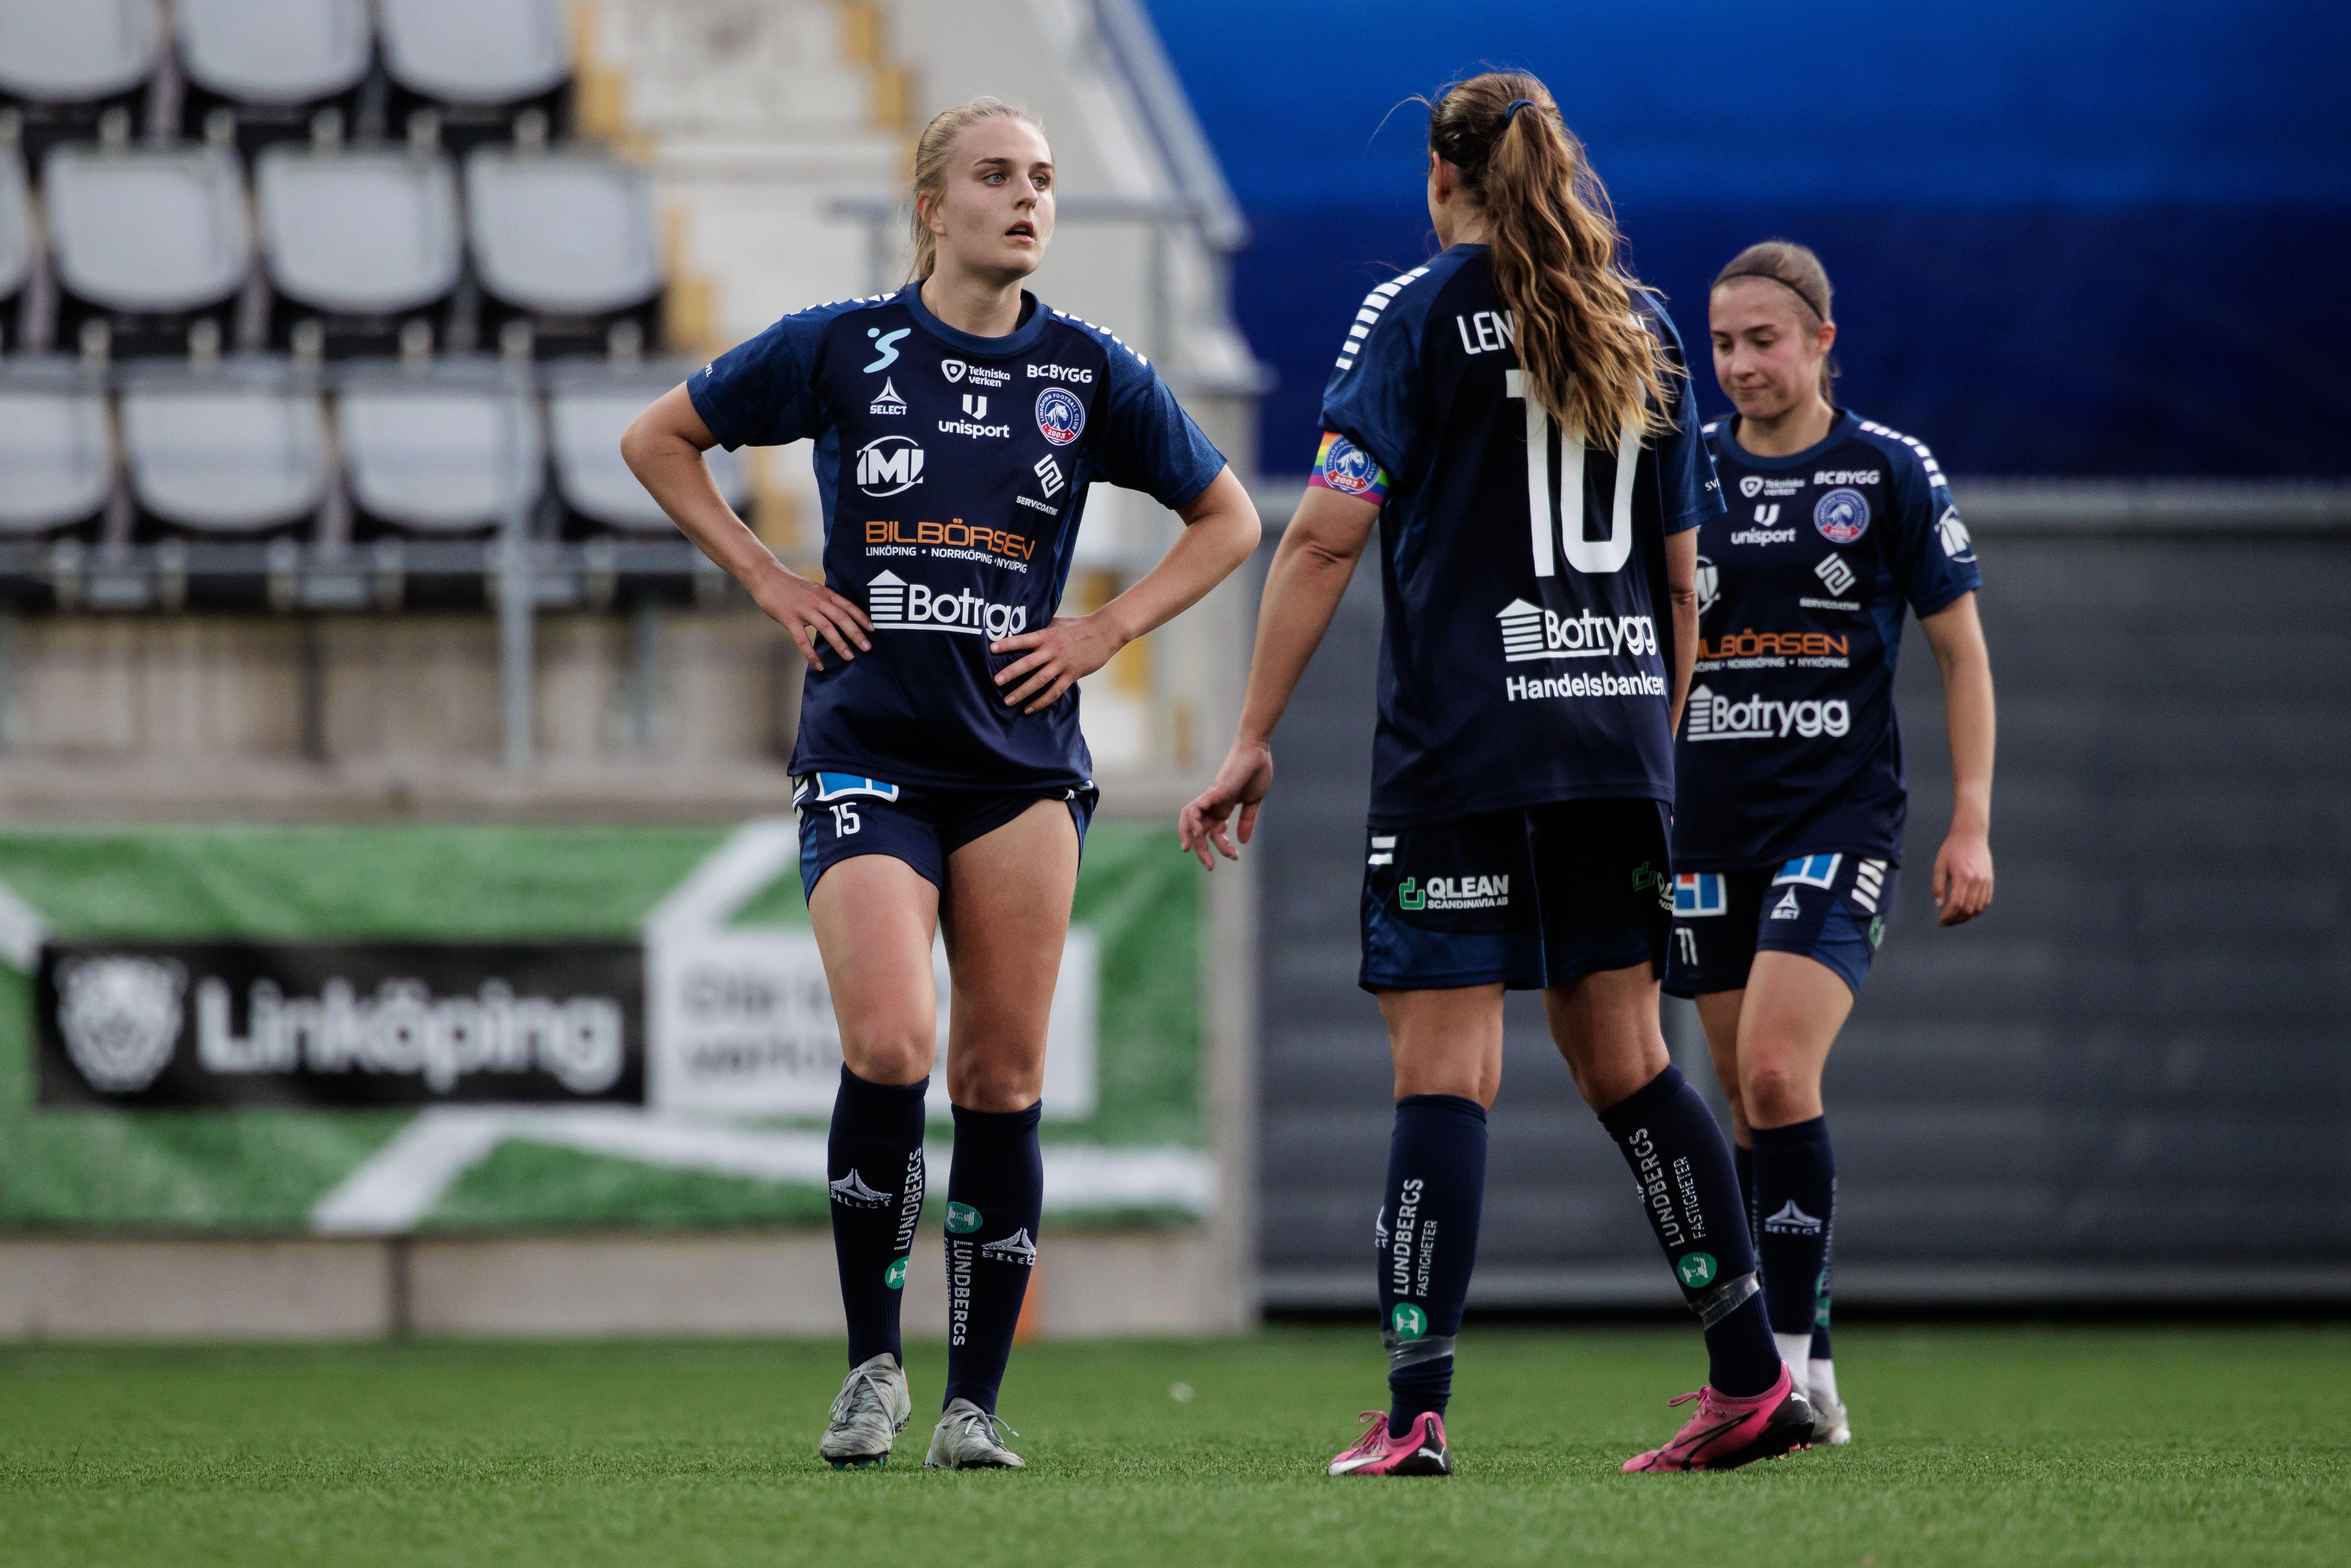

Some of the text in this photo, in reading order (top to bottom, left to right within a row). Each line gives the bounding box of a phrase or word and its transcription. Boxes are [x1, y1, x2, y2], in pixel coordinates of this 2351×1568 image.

[969, 366, 1010, 380] Tekniska
[969, 376, 1001, 387] verken
[1027, 364, 1092, 383] BCBYGG
[870, 405, 907, 415] SELECT
[1040, 394, 1052, 422] LINKÖPING
[1053, 394, 1078, 412] FOOTBALL
[938, 419, 1009, 439] unisport
[1047, 429, 1066, 439] 2003
[1333, 475, 1358, 487] 2003
[1505, 369, 1644, 577] 10
[1813, 470, 1881, 485] BCBYGG
[1016, 496, 1058, 516] SERVICOATING
[1730, 527, 1796, 547] unisport
[866, 545, 916, 556] LINKÖPING
[931, 548, 992, 564] NORRKÖPING
[908, 584, 1026, 642] Botrgg
[1545, 608, 1656, 656] Botrygg
[1698, 627, 1849, 658] ILBÖRSEN
[1798, 656, 1850, 668] NYKÖPING
[1506, 671, 1666, 702] Handelsbanken
[1712, 693, 1851, 738] Botrygg
[829, 802, 860, 838] 15
[1426, 874, 1509, 900] QLEAN
[1427, 896, 1508, 909] SCANDINAVIA AB
[198, 975, 624, 1094] Linköping
[1394, 1178, 1425, 1296] LUNDBERGS
[1416, 1220, 1438, 1297] FASTIGHETER
[953, 1240, 973, 1346] LUNDBERGS
